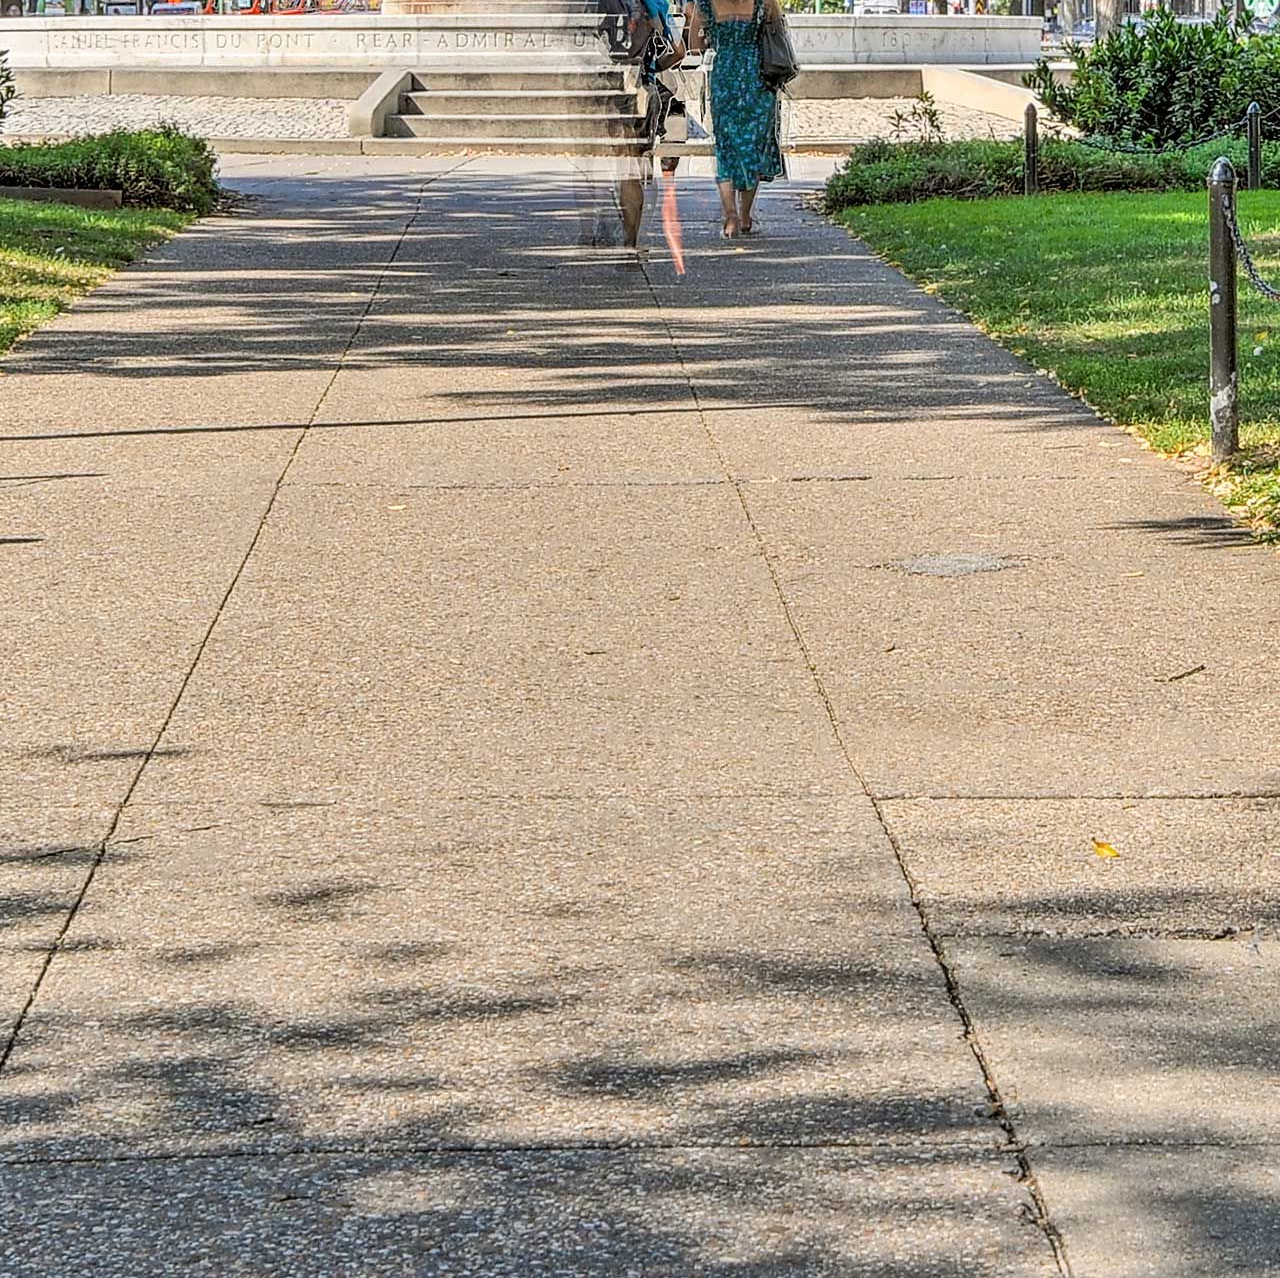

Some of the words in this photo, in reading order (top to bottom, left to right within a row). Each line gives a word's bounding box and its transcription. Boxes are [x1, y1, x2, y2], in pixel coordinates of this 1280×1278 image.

[123, 33, 199, 49] FRANCIS
[215, 33, 242, 49] DU
[257, 33, 315, 49] PONT
